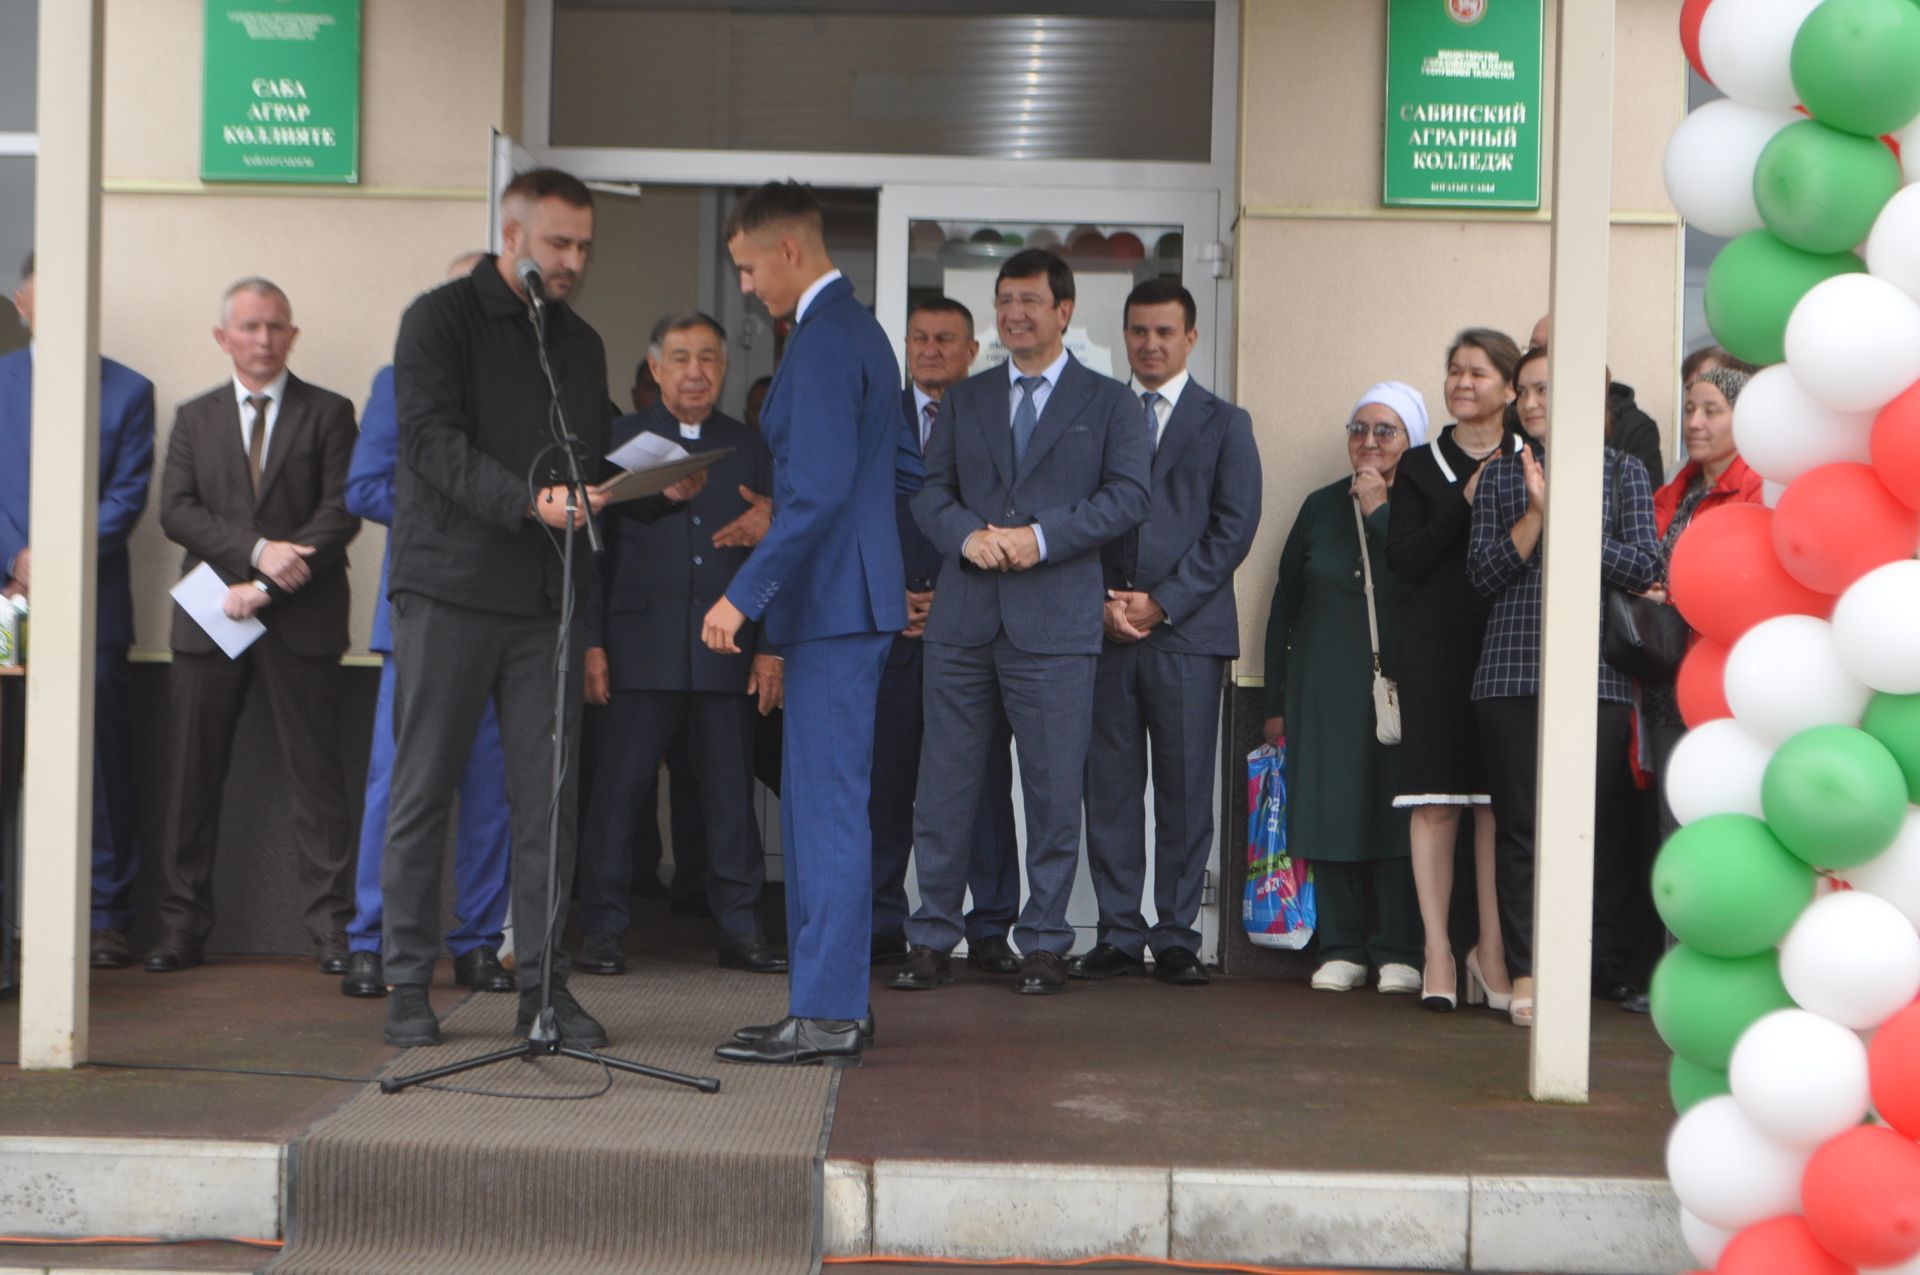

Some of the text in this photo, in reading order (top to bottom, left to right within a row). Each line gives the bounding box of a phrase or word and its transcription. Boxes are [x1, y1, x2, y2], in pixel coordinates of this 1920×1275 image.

[251, 78, 307, 98] САБА
[247, 102, 311, 122] АГРАР
[1400, 101, 1526, 123] САБИНСКИЙ
[1409, 125, 1517, 147] АГРАРНЫЙ
[1414, 151, 1514, 173] КОЛЛЕДЖ
